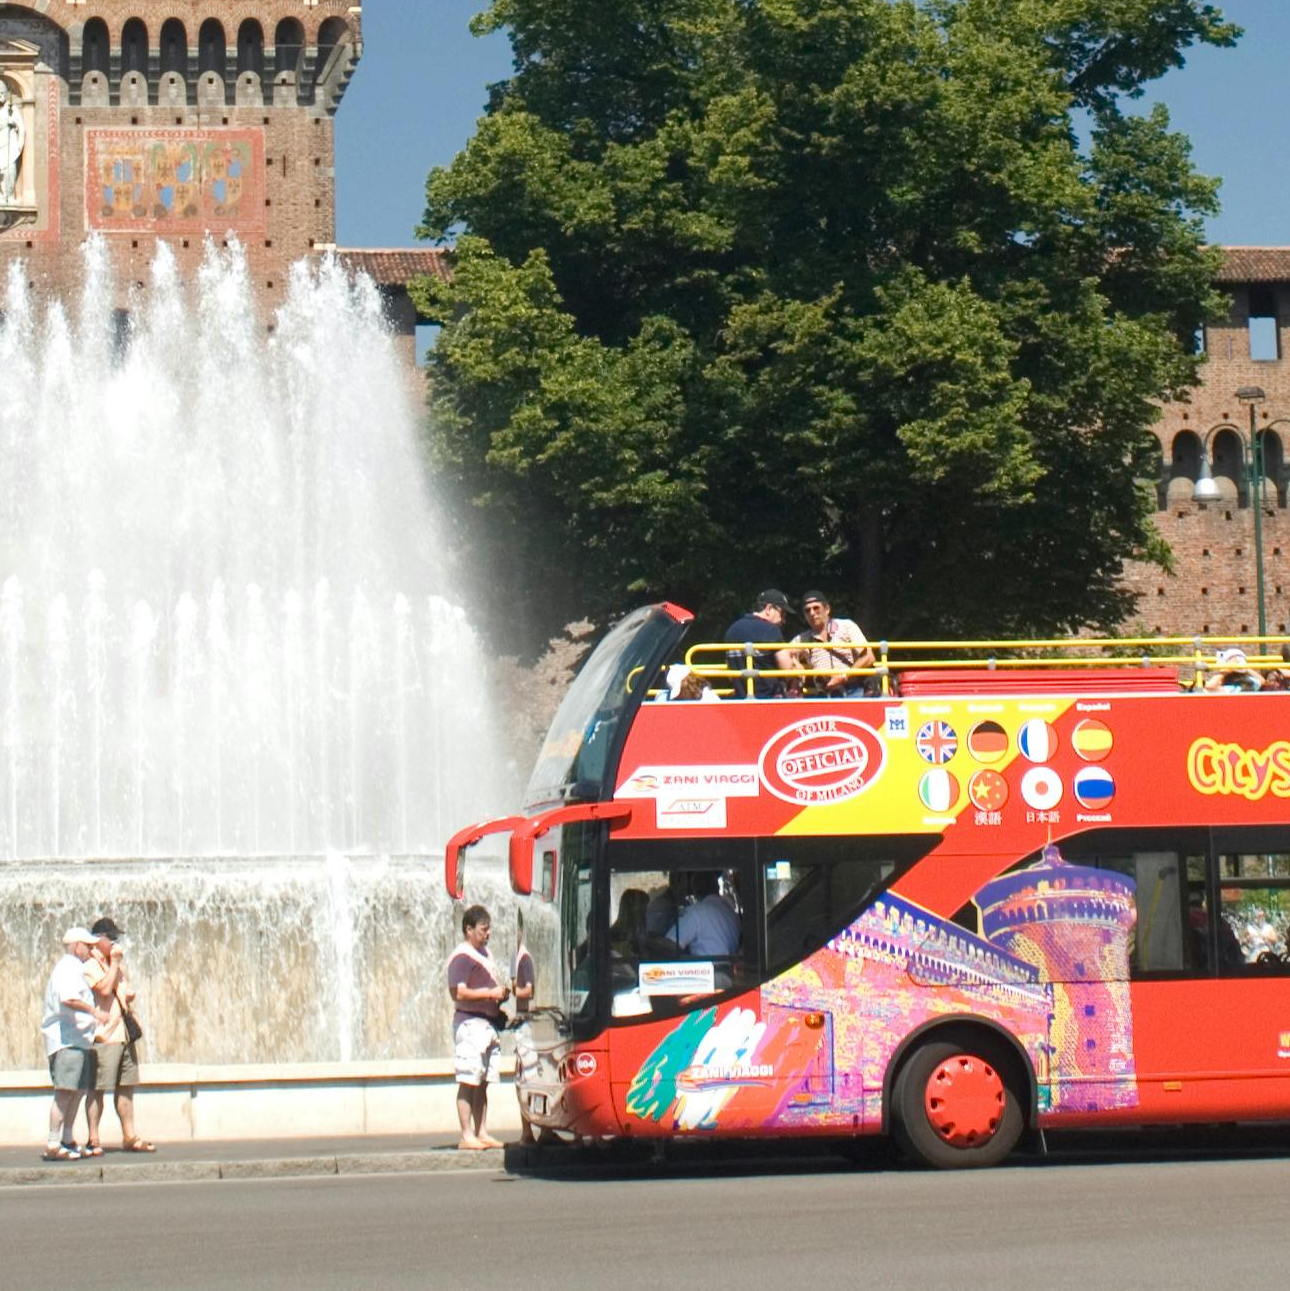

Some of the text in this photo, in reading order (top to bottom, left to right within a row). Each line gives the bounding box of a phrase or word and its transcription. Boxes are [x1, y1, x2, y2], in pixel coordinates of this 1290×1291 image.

[796, 721, 838, 738] TOUR
[782, 745, 862, 776] OFFICIAL
[663, 774, 755, 784] ZANI VIAGGI
[795, 776, 864, 802] OF MILANO
[692, 1065, 774, 1078] ZANI VIAGGI
